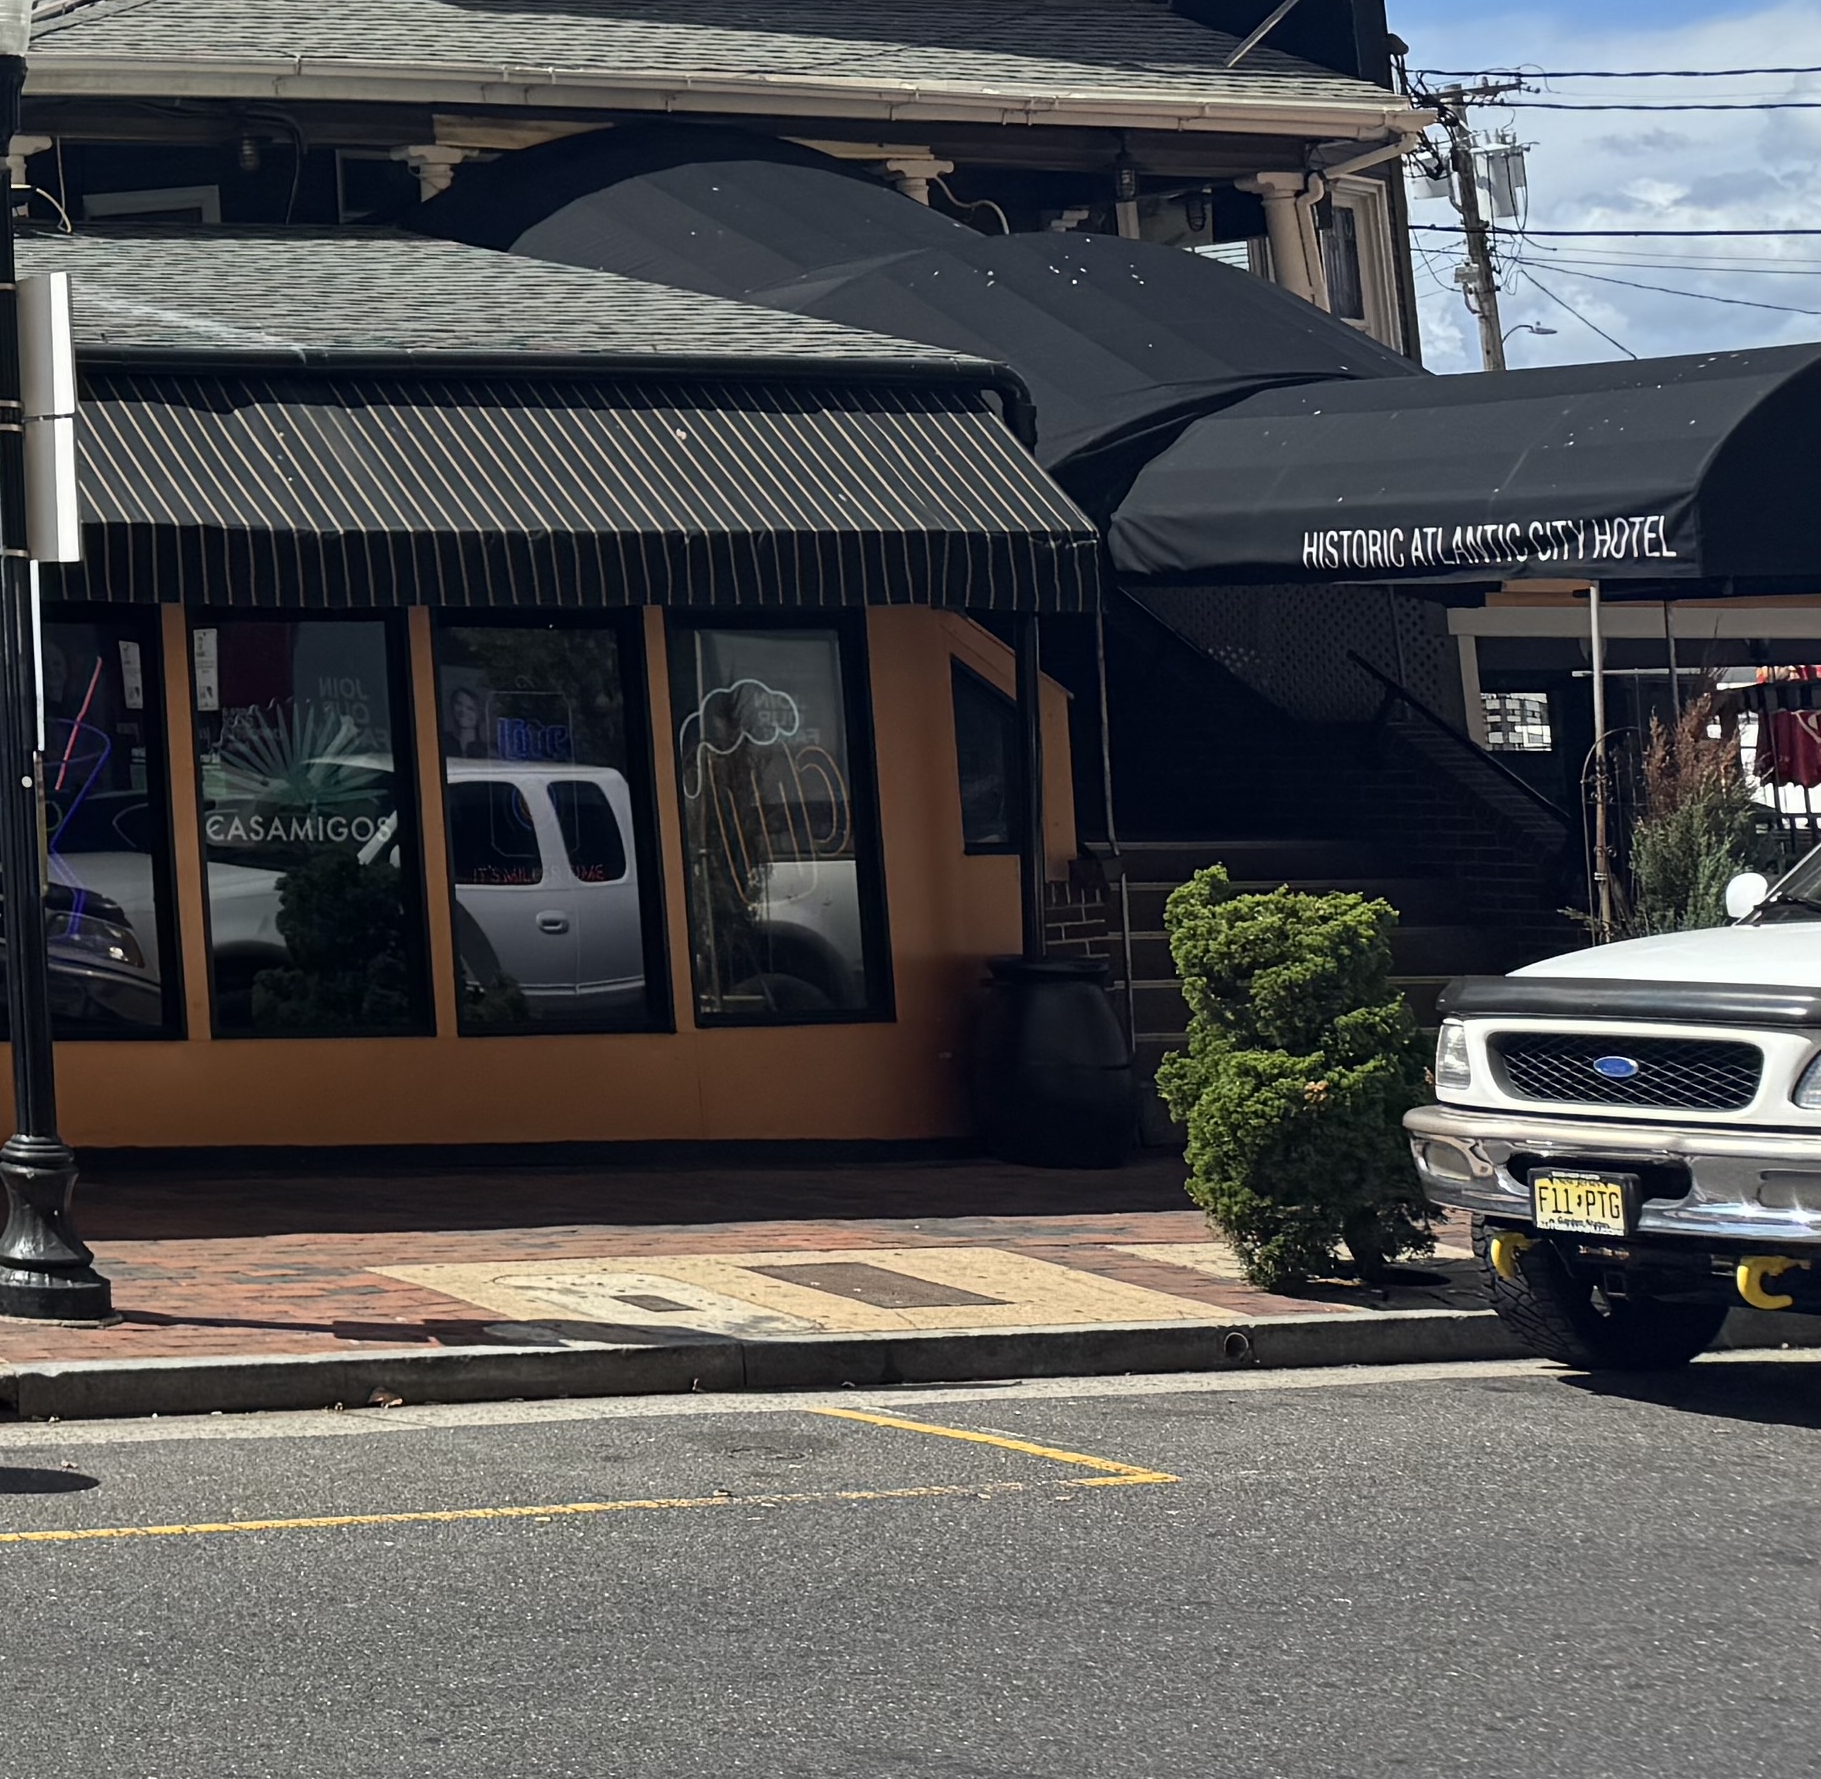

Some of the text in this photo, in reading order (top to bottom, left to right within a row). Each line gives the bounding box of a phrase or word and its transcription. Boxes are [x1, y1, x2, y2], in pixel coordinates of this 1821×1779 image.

[1302, 515, 1677, 570] HISTORIC ATLANTIC CITY HOTEL
[206, 816, 390, 842] CASAMIGOS
